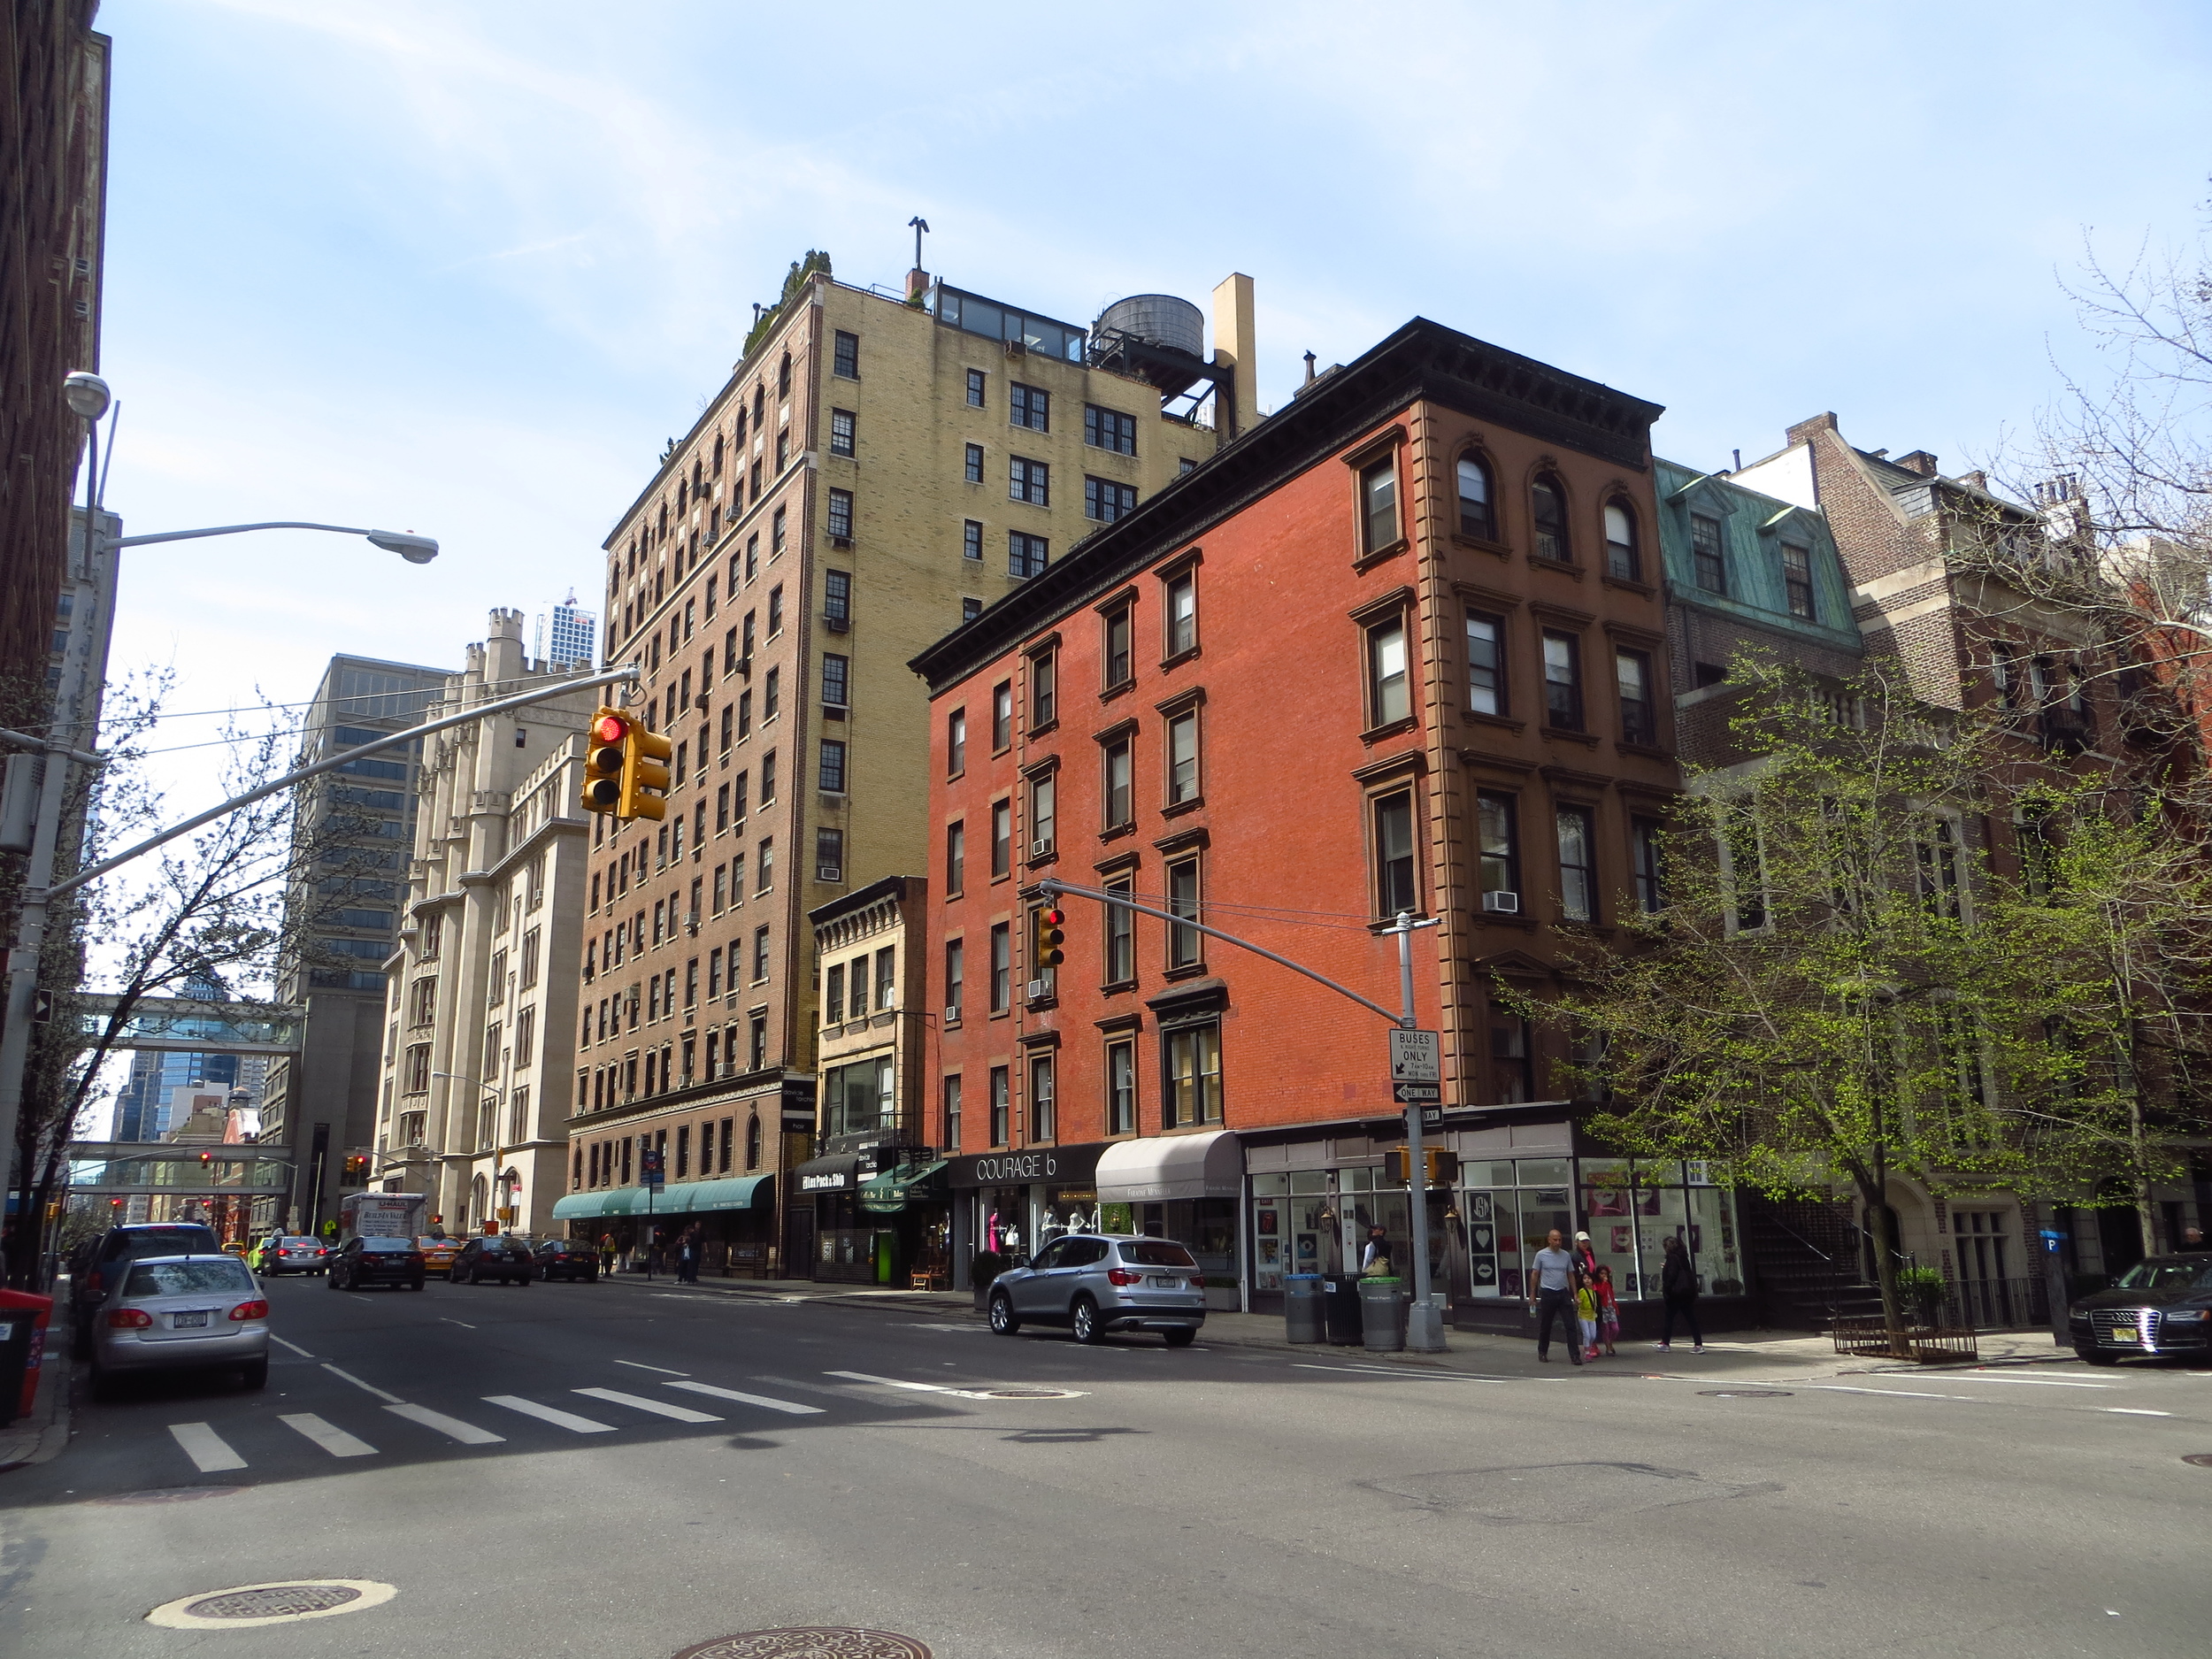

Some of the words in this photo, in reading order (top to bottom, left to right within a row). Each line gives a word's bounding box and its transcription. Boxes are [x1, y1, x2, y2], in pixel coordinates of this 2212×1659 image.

[1399, 1033, 1430, 1044] BUSES
[1403, 1050, 1427, 1061] ONLY
[977, 1155, 1041, 1180] COURAGE
[1047, 1153, 1056, 1176] b
[817, 1175, 829, 1187] Pack
[833, 1173, 845, 1187] Ship
[2048, 1240, 2055, 1251] P
